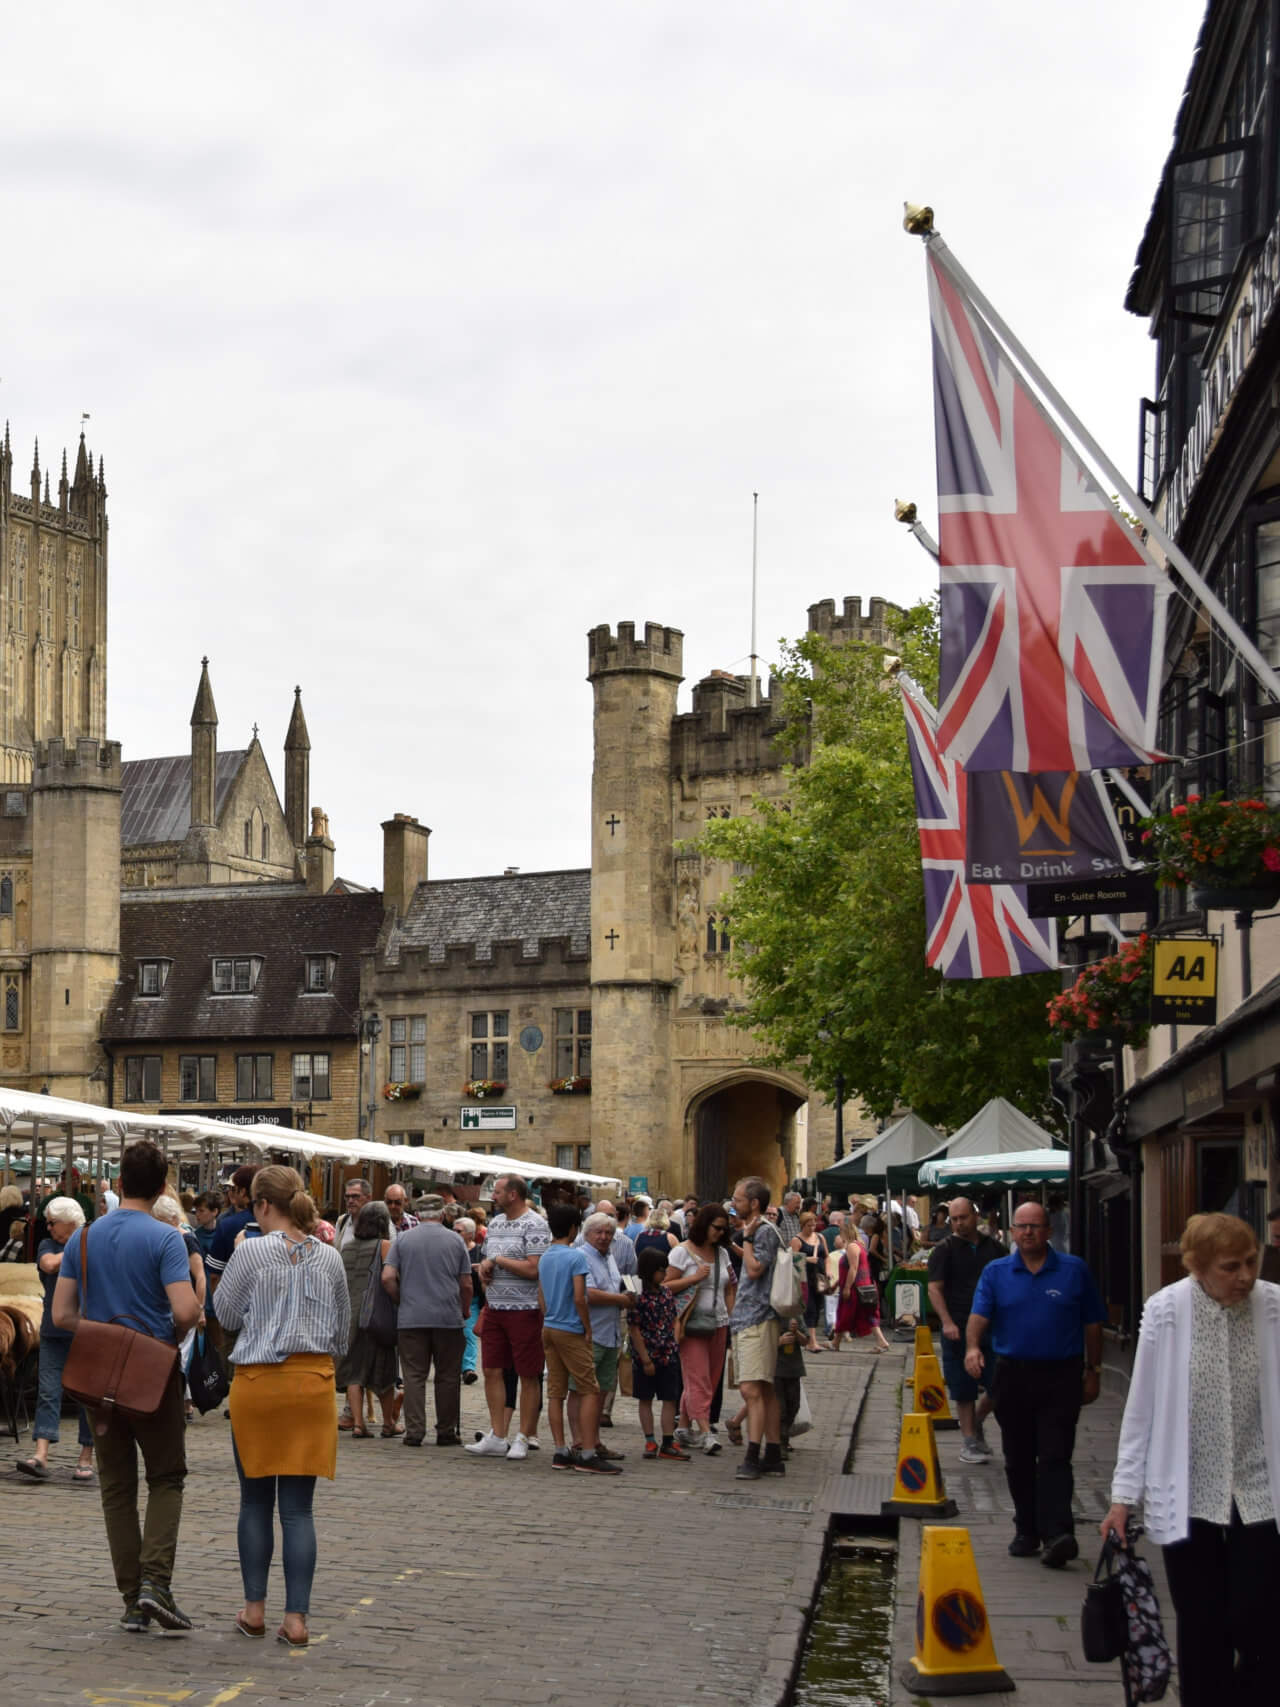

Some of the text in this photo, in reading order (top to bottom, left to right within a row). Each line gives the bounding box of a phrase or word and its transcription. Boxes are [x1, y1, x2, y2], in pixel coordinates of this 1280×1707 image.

[972, 864, 1003, 879] Eat
[1021, 861, 1075, 879] Drink
[1071, 891, 1095, 901] Suite
[1097, 889, 1128, 900] Rooms
[1165, 955, 1205, 981] AA
[216, 1114, 280, 1125] Cathedral Shop
